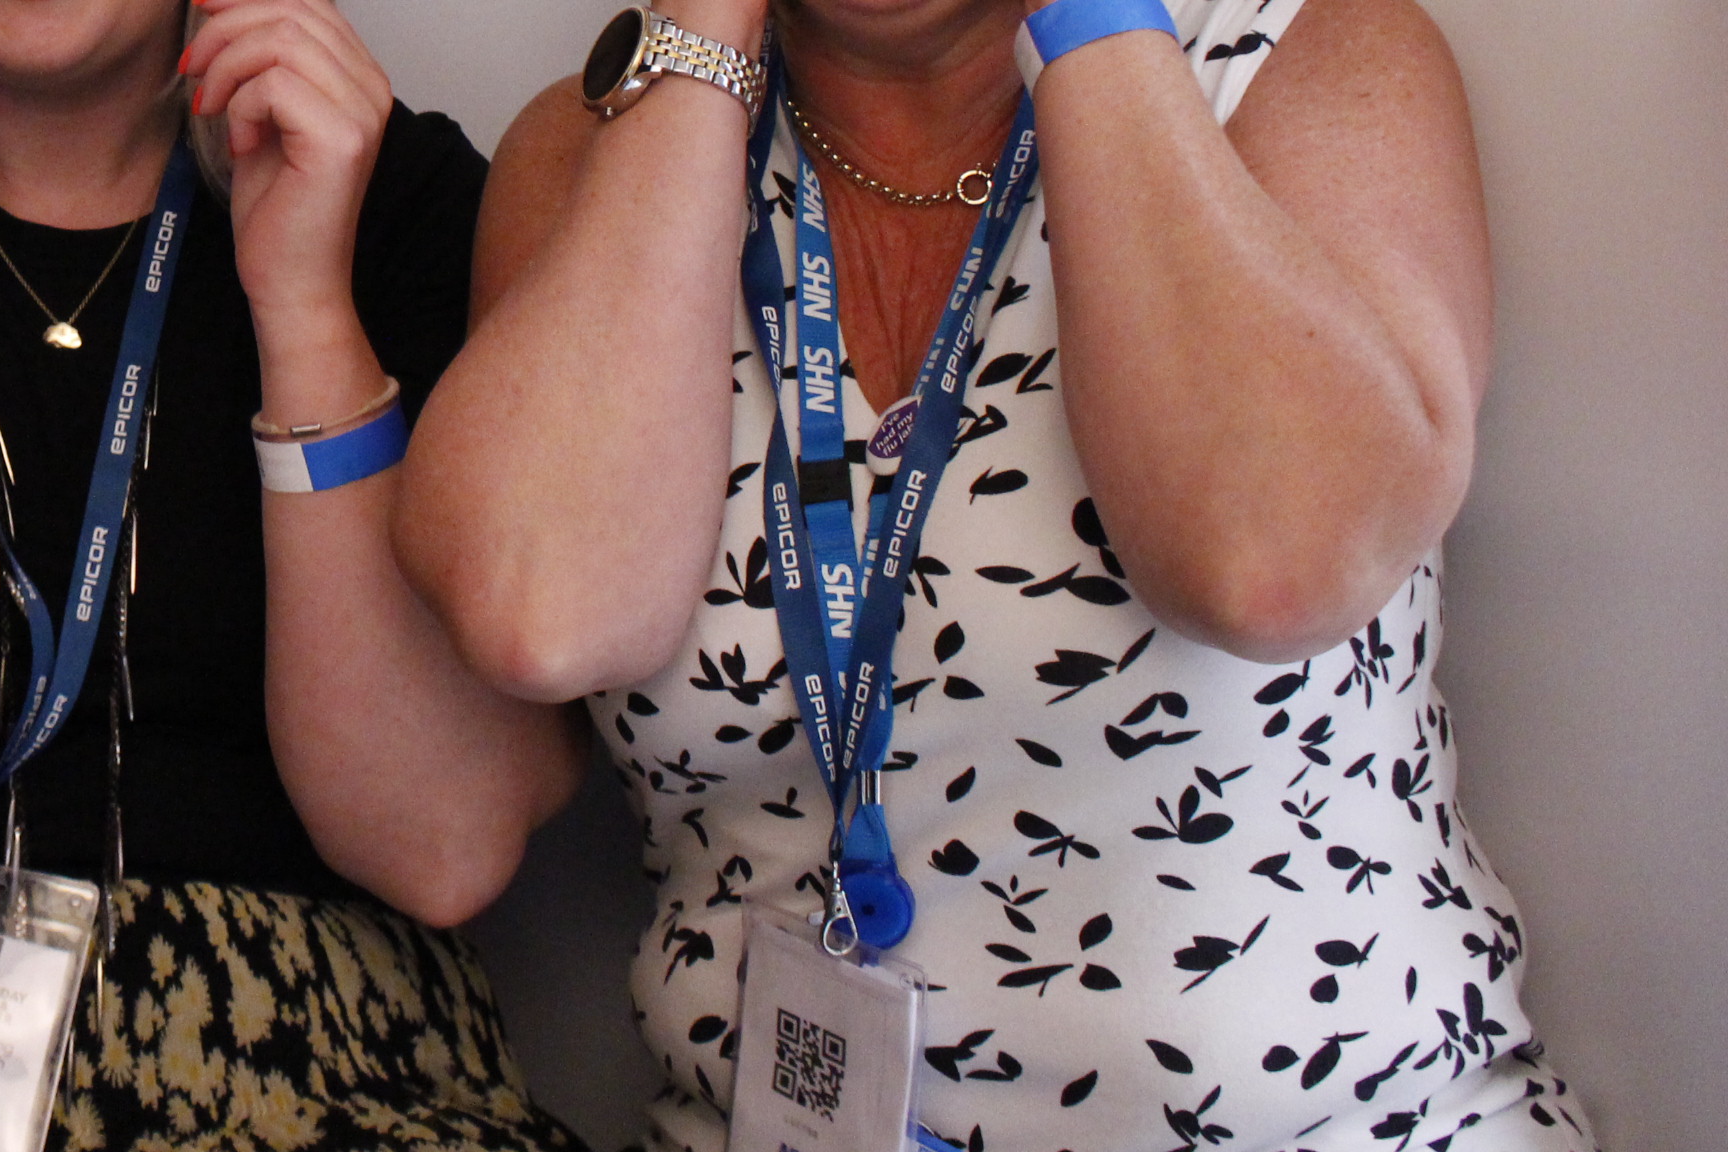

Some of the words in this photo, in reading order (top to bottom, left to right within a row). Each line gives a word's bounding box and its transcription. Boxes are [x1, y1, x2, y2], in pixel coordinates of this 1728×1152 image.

[803, 162, 826, 233] NHS
[803, 251, 832, 322] NHS
[762, 306, 782, 391] EPICO
[804, 345, 836, 414] NHS
[875, 427, 896, 450] had
[897, 411, 913, 429] my
[821, 563, 855, 639] NHS
